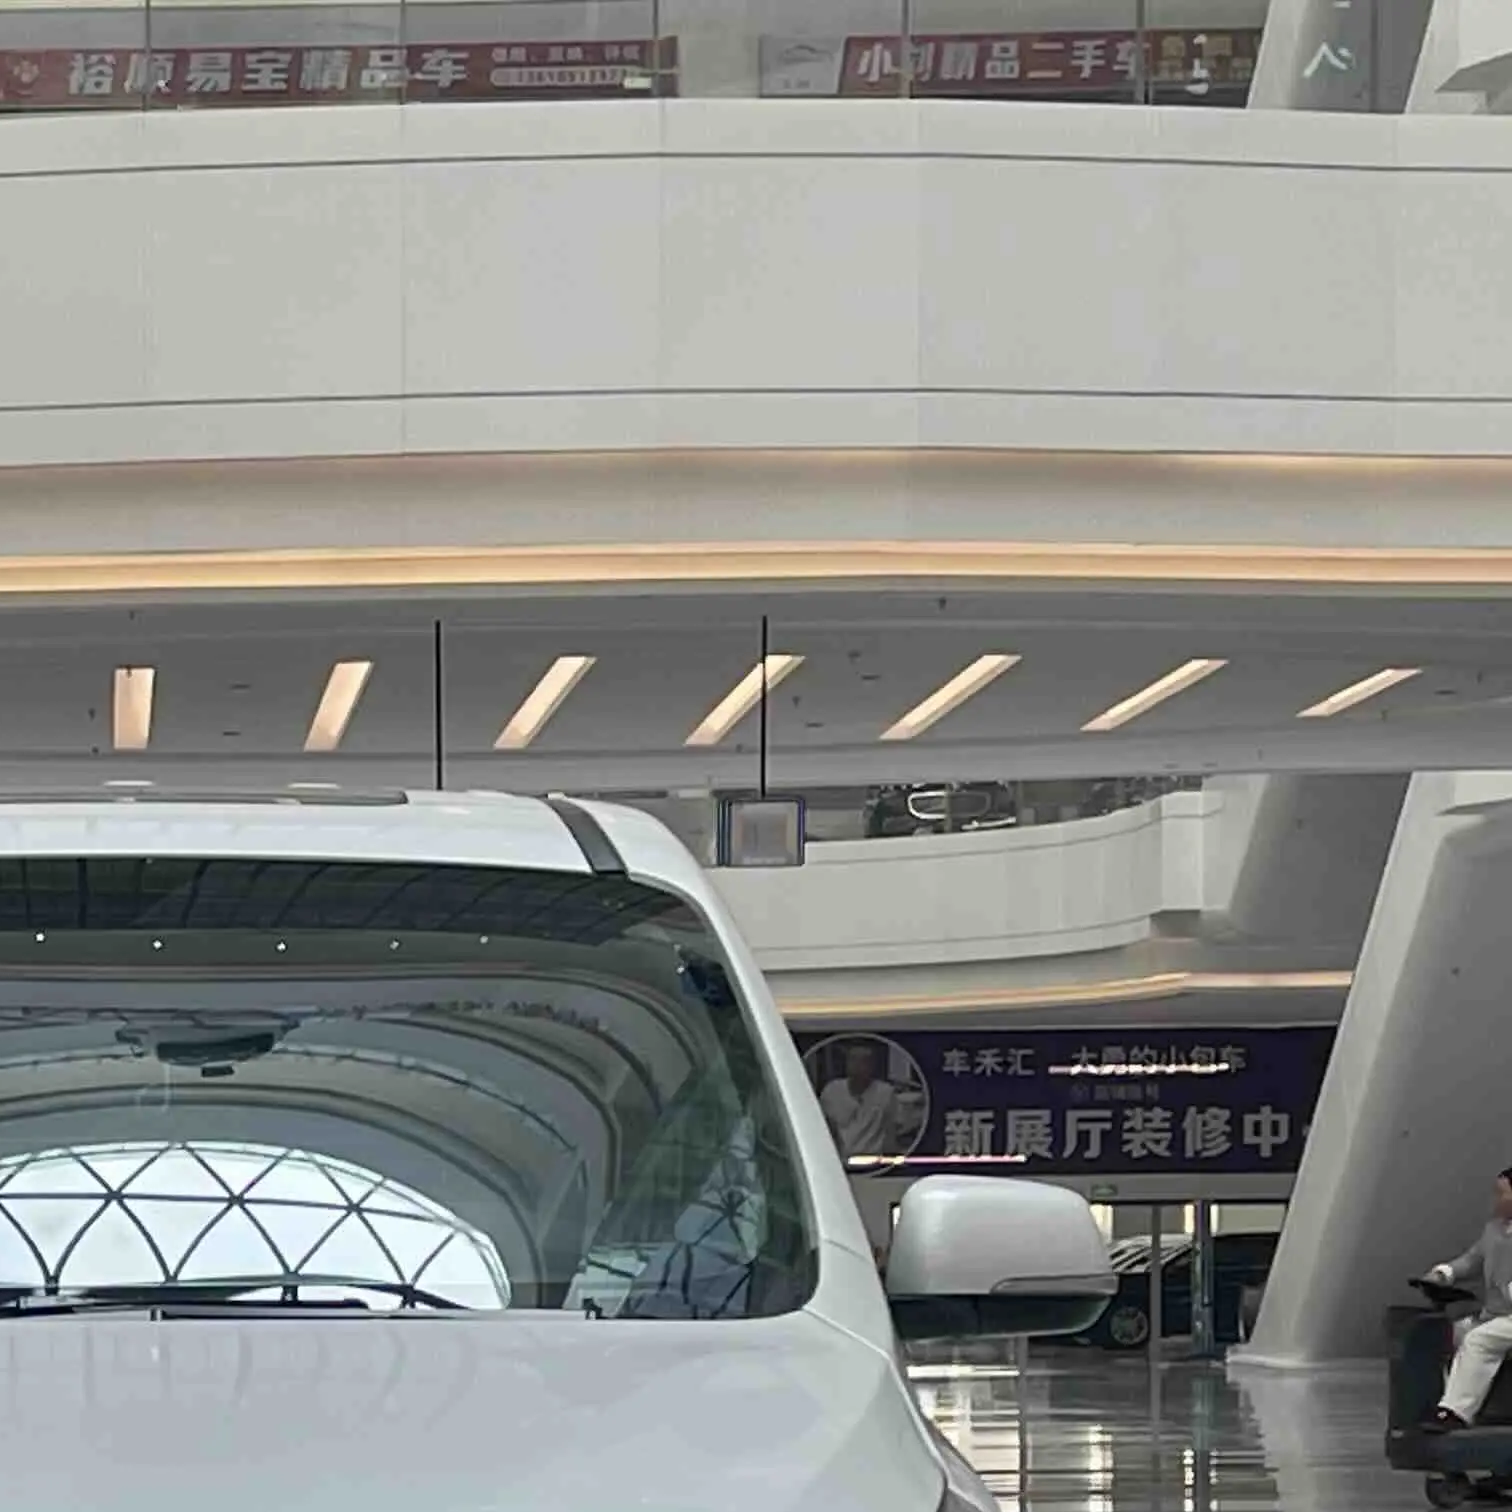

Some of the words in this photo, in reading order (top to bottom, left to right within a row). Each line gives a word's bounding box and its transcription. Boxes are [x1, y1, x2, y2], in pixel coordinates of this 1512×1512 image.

[943, 1048, 1035, 1076] 车禾汇
[943, 1105, 1290, 1159] 新展厅装修中
